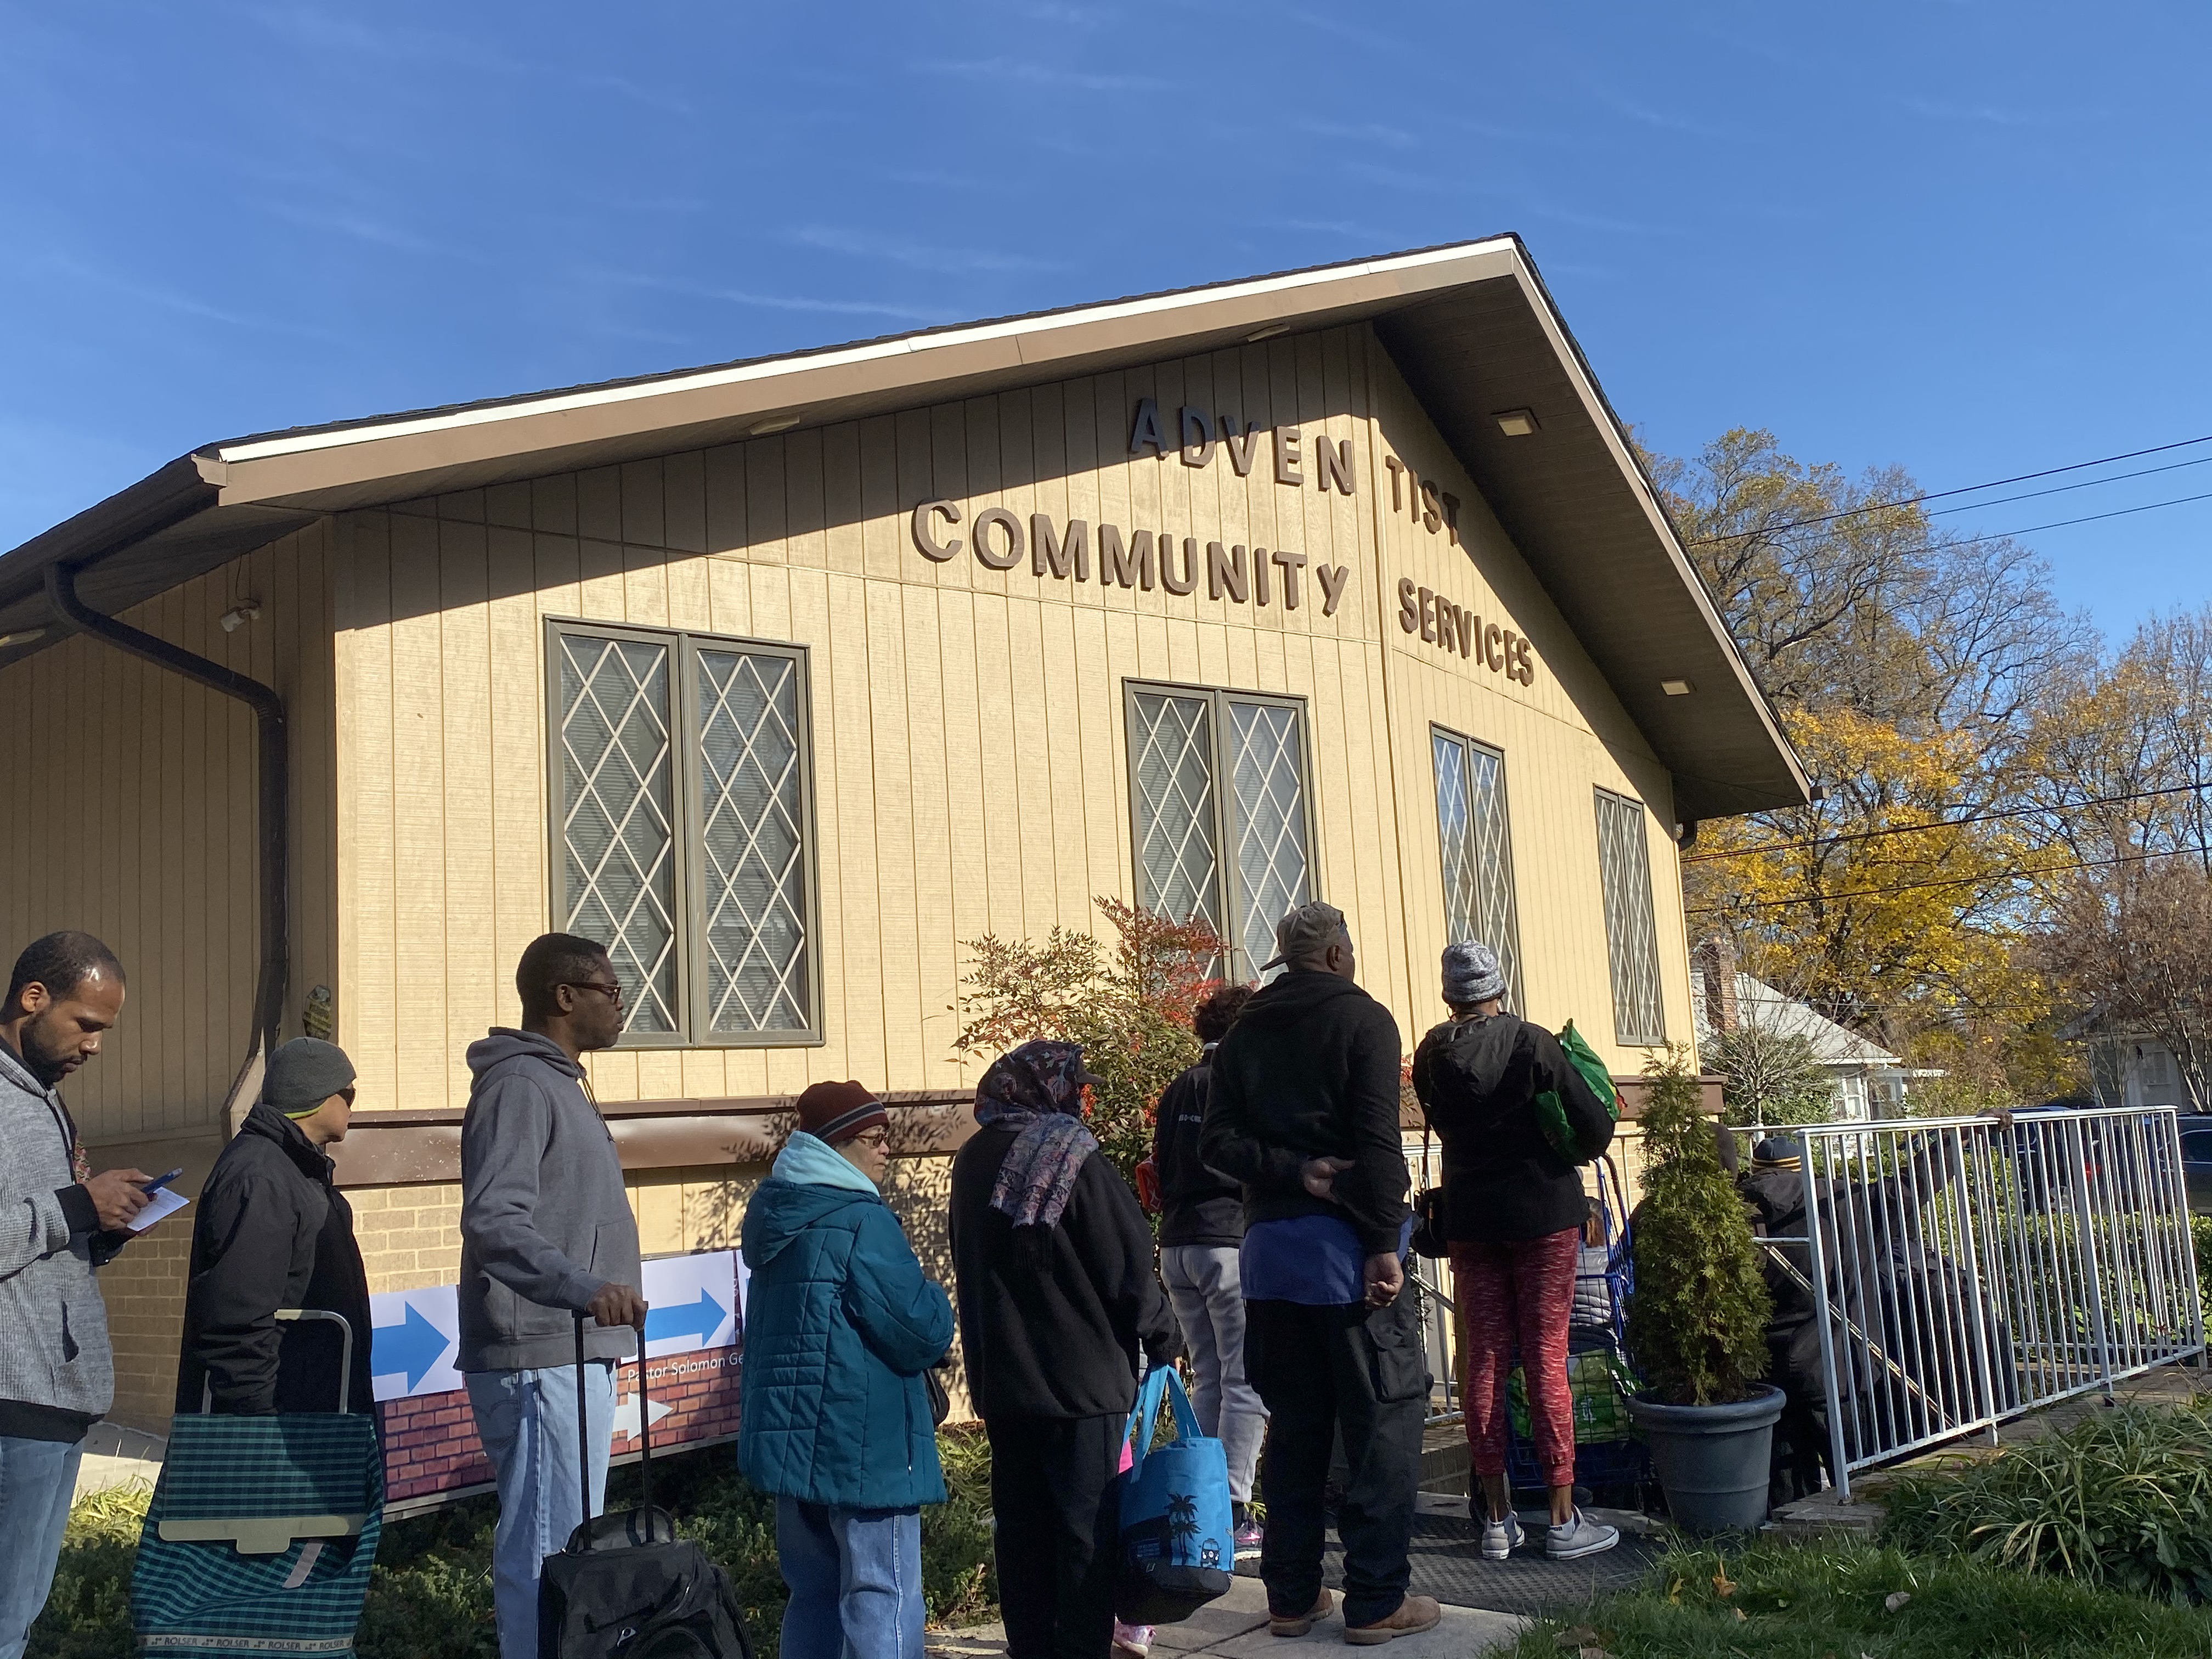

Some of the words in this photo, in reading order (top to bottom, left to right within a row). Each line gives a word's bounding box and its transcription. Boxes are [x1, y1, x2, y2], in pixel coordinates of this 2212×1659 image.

[1130, 398, 1355, 495] ADVEN
[1385, 455, 1460, 547] TIST
[911, 498, 1350, 617] COMMUNITY
[1397, 577, 1535, 686] SERVICES
[671, 1357, 725, 1376] Solomon
[165, 1637, 198, 1646] ROLSER
[216, 1639, 249, 1648] ROLSER
[268, 1642, 301, 1651] ROLSER
